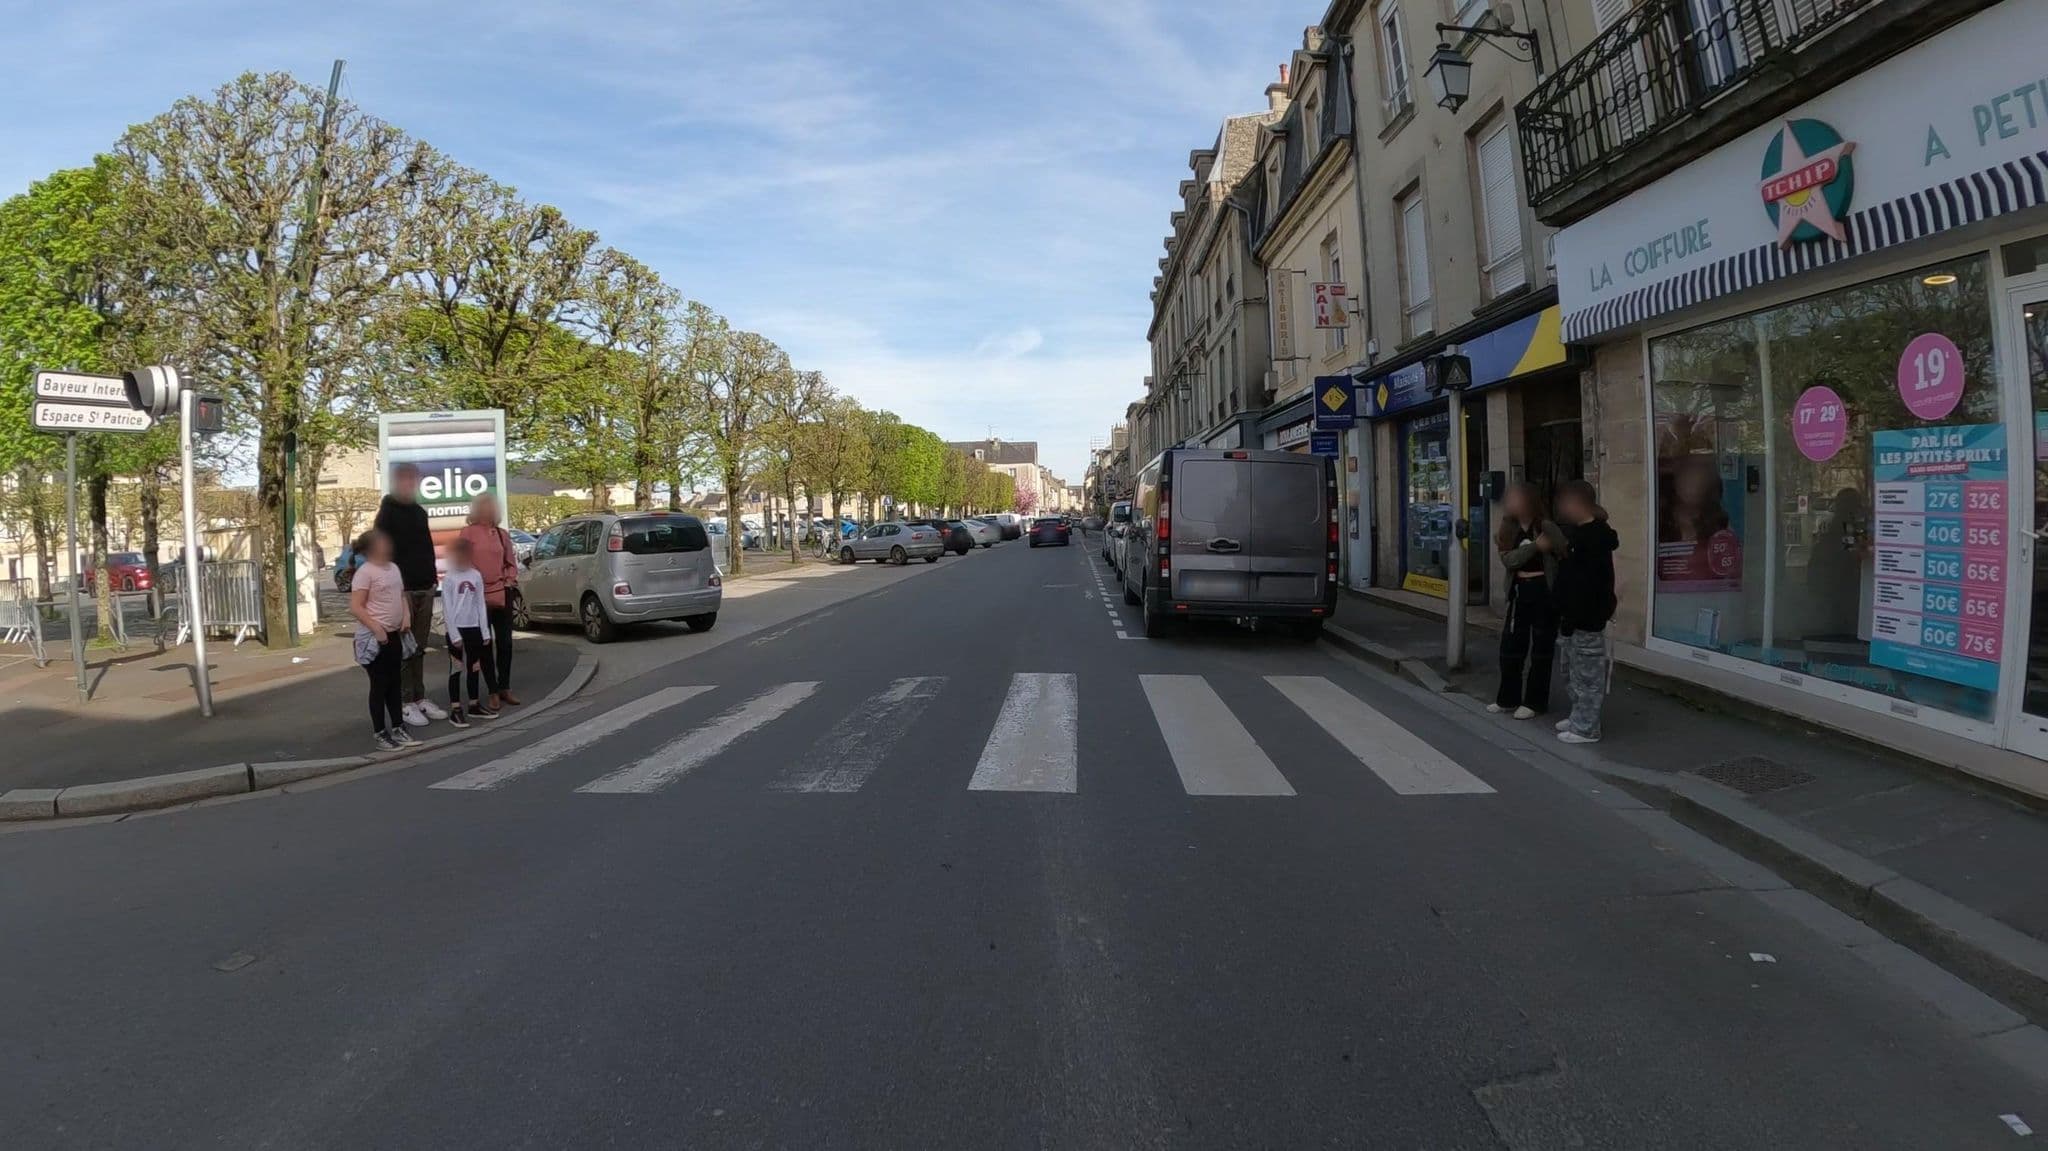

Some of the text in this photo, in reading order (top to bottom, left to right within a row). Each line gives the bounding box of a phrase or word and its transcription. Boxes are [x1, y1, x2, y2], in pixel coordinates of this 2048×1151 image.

[1924, 123, 1951, 166] A
[1765, 161, 1830, 199] TCHIP
[1590, 218, 1712, 292] LA COIFFURE
[1315, 285, 1330, 326] PAIN
[43, 378, 88, 394] Bayeux
[41, 408, 83, 424] Espace
[102, 411, 143, 426] Patrice
[1911, 433, 1963, 449] PAR ICI
[1880, 452, 1901, 465] LES
[1904, 449, 1953, 463] PETITS
[1956, 448, 1992, 462] PRIX
[1928, 492, 1960, 509] 27€
[1968, 492, 2000, 510] 32€
[1927, 526, 2000, 546] 40€ 55€
[1927, 560, 1960, 577] 50€
[1967, 564, 2000, 582] 65€
[1925, 594, 1999, 618] 50€ 65€
[1923, 627, 1996, 654] 60€ 75€
